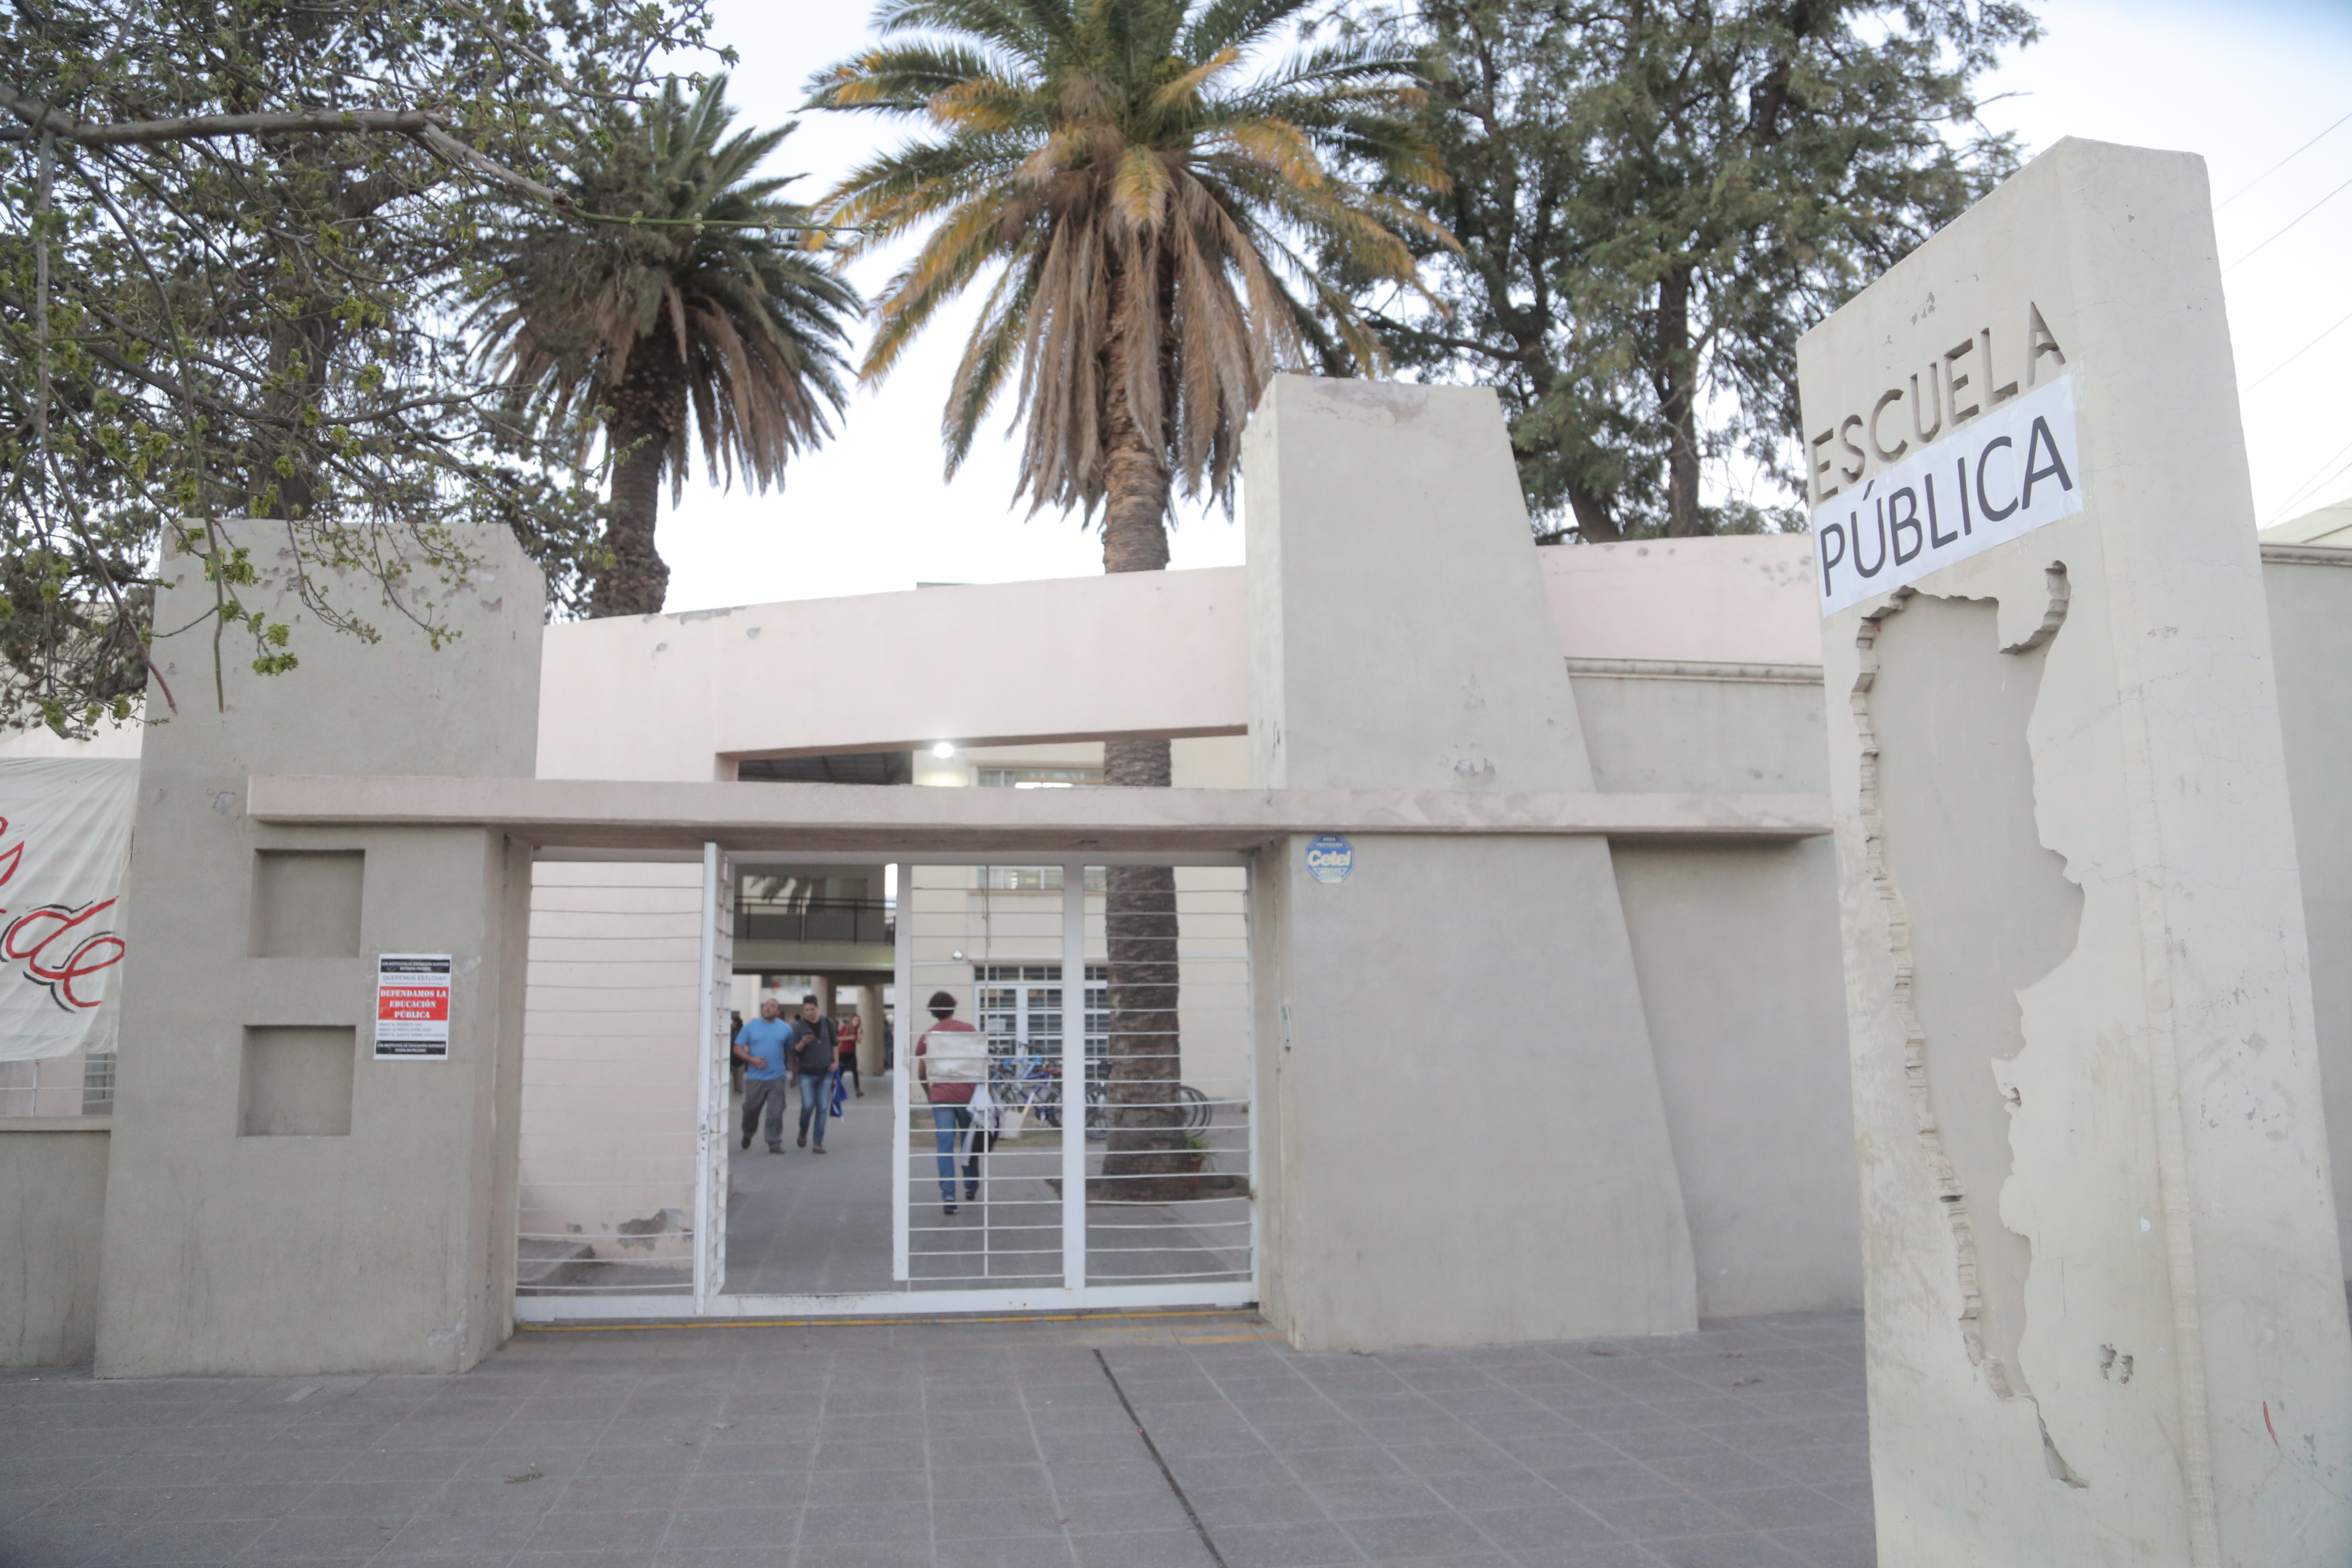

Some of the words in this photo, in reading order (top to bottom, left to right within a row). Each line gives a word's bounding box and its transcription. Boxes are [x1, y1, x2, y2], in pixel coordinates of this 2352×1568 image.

[1811, 301, 2066, 503] ESCUELA
[1820, 415, 2073, 597] PÚBLICA
[1308, 850, 1352, 866] Cetel
[389, 999, 437, 1008] EDUCACIÓN
[394, 1010, 431, 1018] PÚBLICA
